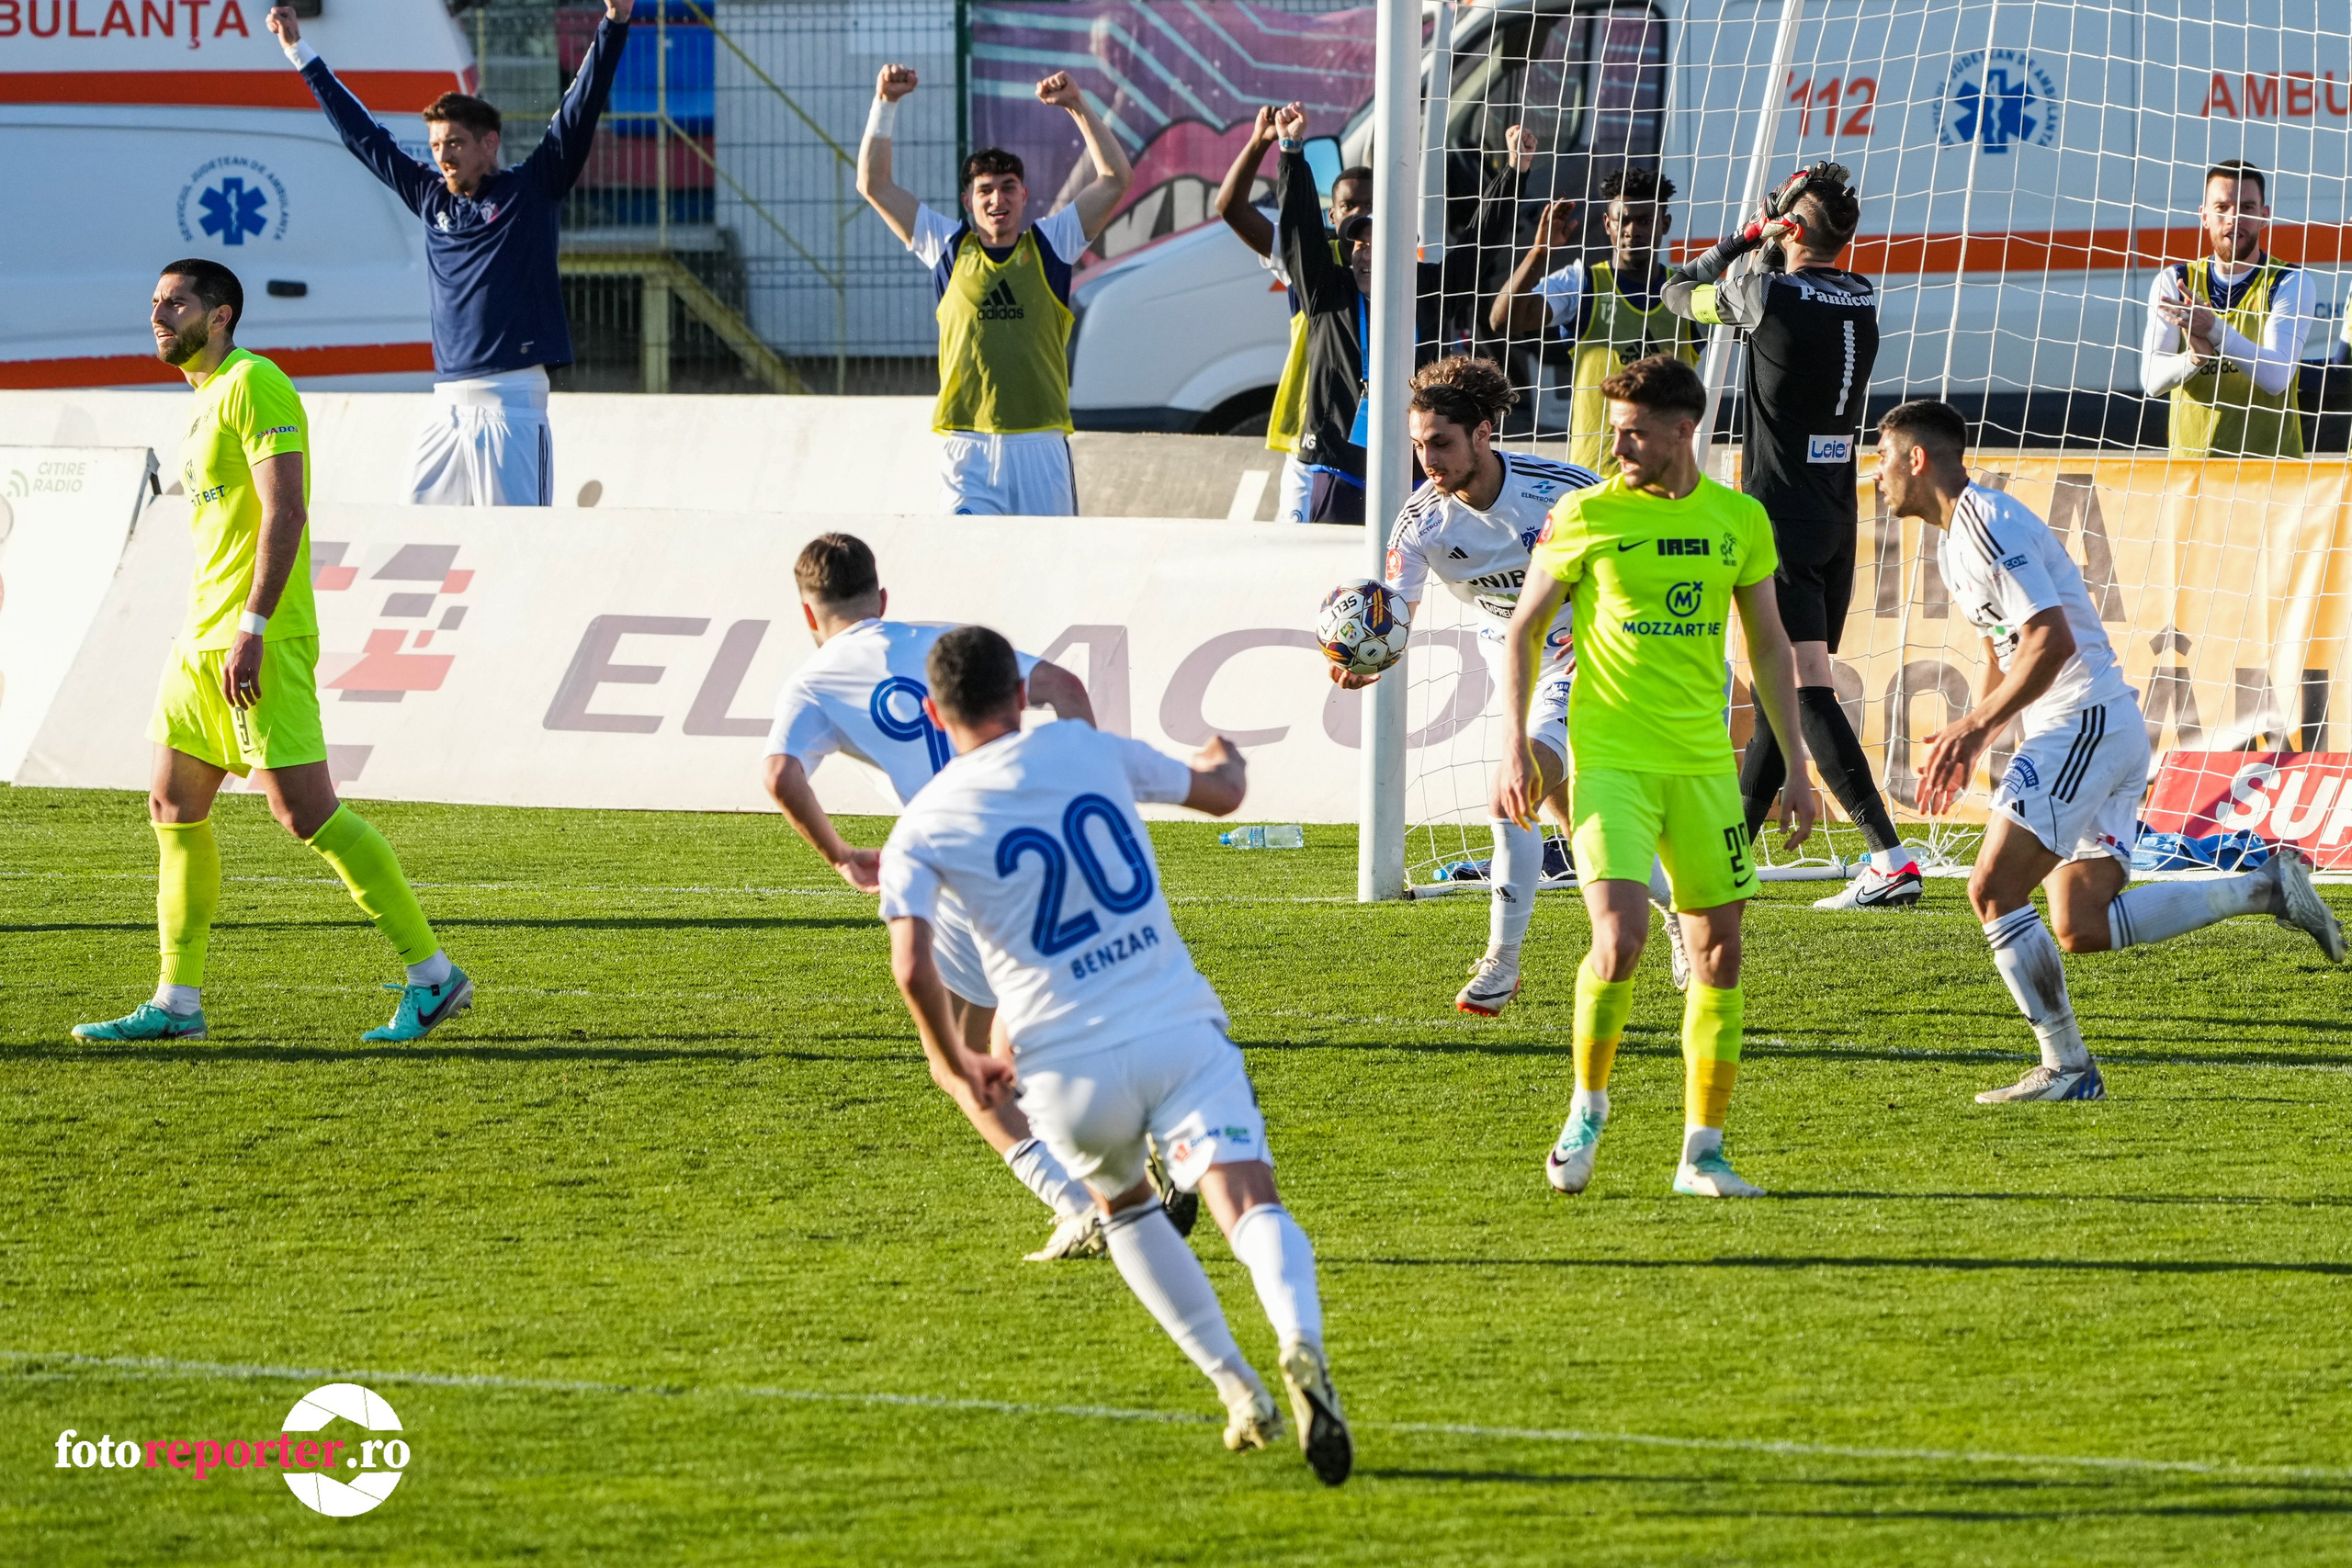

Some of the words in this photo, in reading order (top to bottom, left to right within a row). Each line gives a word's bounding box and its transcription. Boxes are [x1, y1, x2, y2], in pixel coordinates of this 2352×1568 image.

[1791, 77, 1878, 137] 112
[977, 304, 1024, 321] adidas
[1836, 321, 1855, 416] 1
[38, 462, 86, 476] CITIRE
[33, 479, 83, 492] RADIO
[203, 484, 225, 503] BET
[1657, 538, 1710, 556] IASI
[1623, 622, 1702, 637] MOZZART
[870, 676, 951, 776] 9
[995, 793, 1154, 957] 20
[1070, 926, 1159, 980] BENZAR
